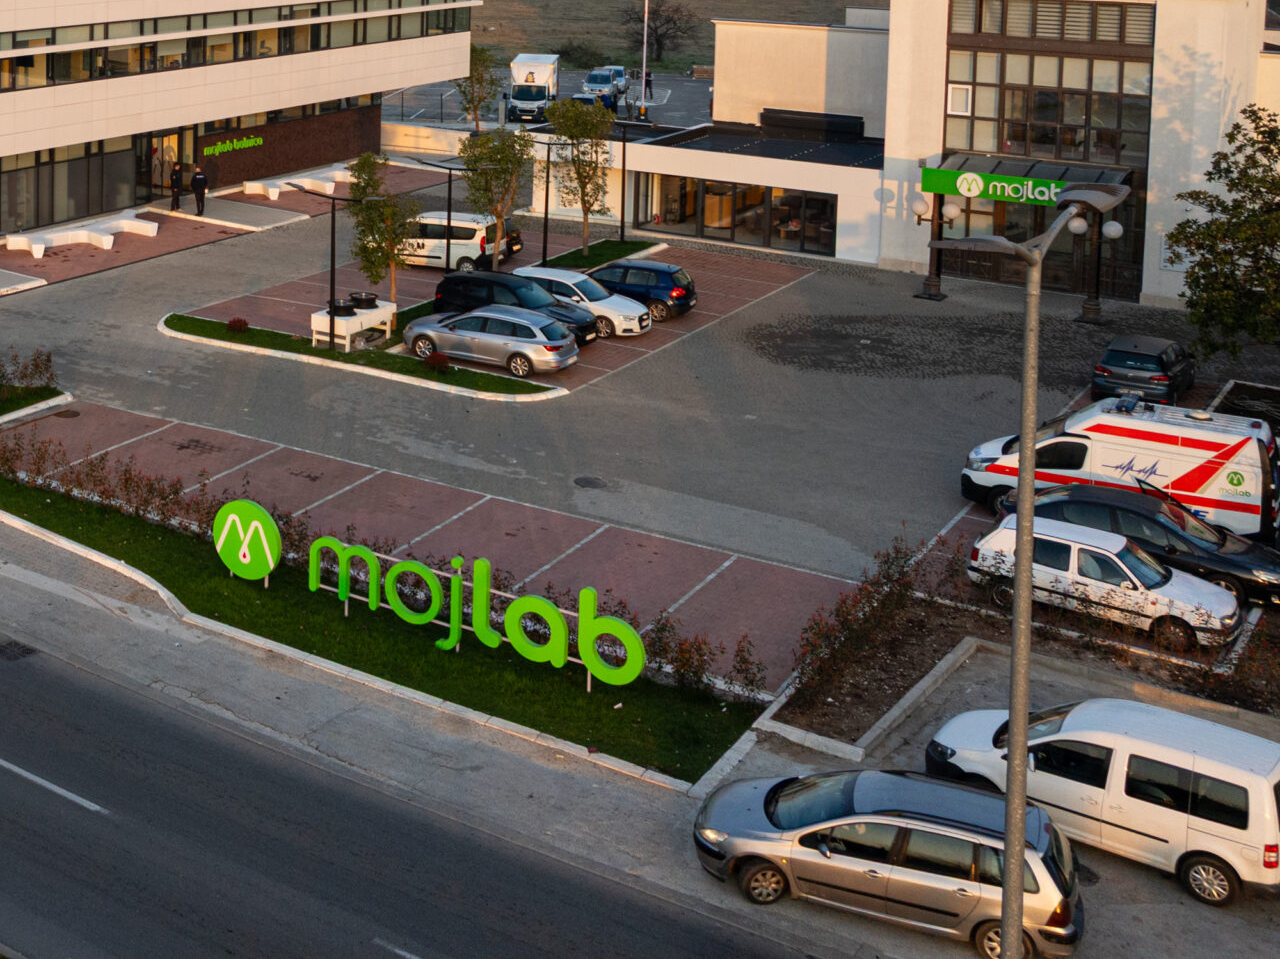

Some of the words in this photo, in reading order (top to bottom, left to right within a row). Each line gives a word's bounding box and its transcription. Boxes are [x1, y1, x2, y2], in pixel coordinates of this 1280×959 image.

[204, 140, 233, 156] mojlab
[233, 135, 263, 150] bolnica
[1219, 487, 1251, 498] mojlab
[308, 536, 646, 686] mojlab
